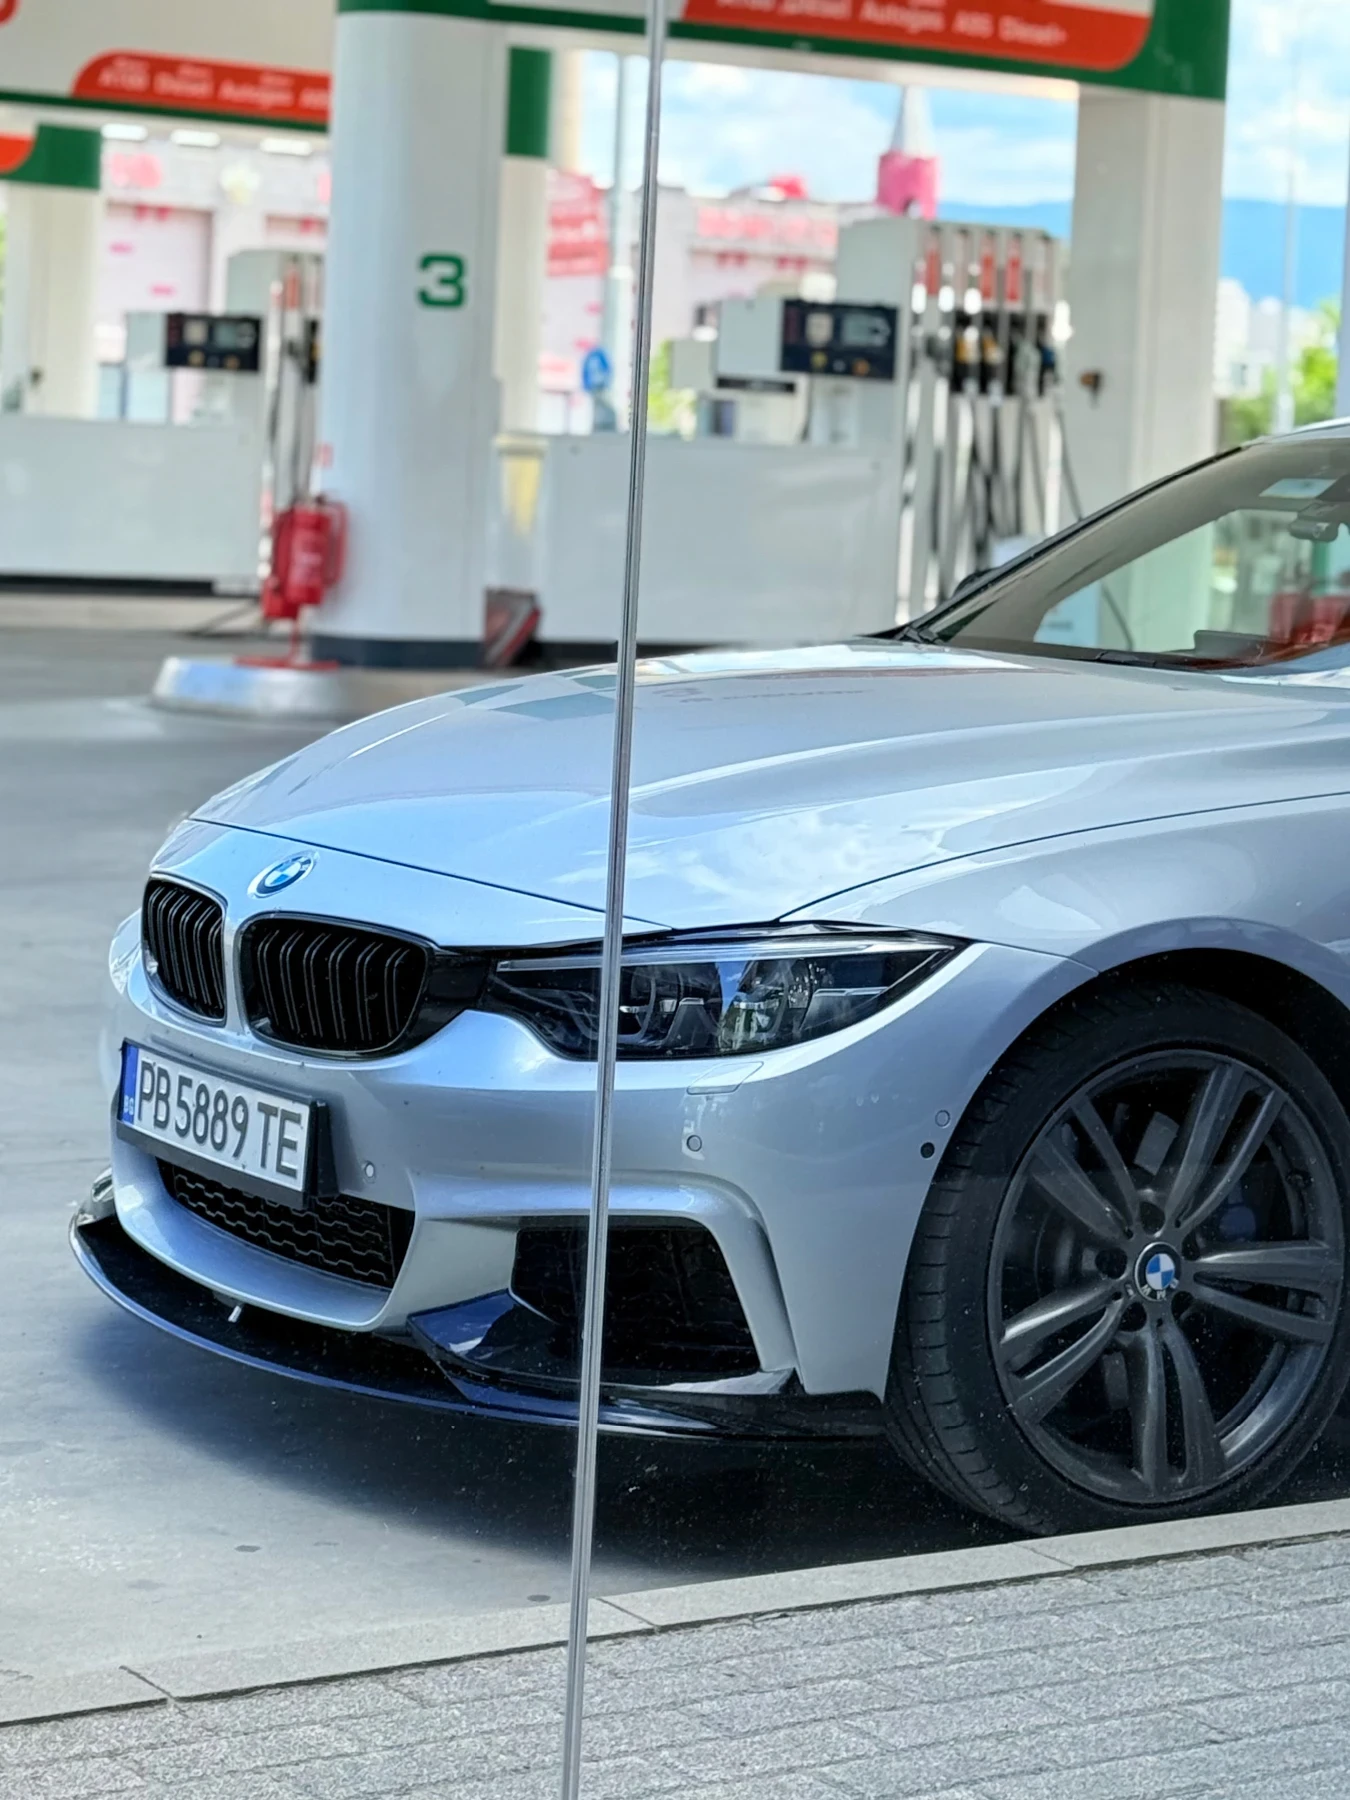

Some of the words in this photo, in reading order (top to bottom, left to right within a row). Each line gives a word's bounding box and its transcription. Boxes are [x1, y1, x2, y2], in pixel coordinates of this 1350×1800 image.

[418, 252, 466, 308] 3
[173, 1073, 250, 1158] 5889
[256, 1100, 303, 1180] TE
